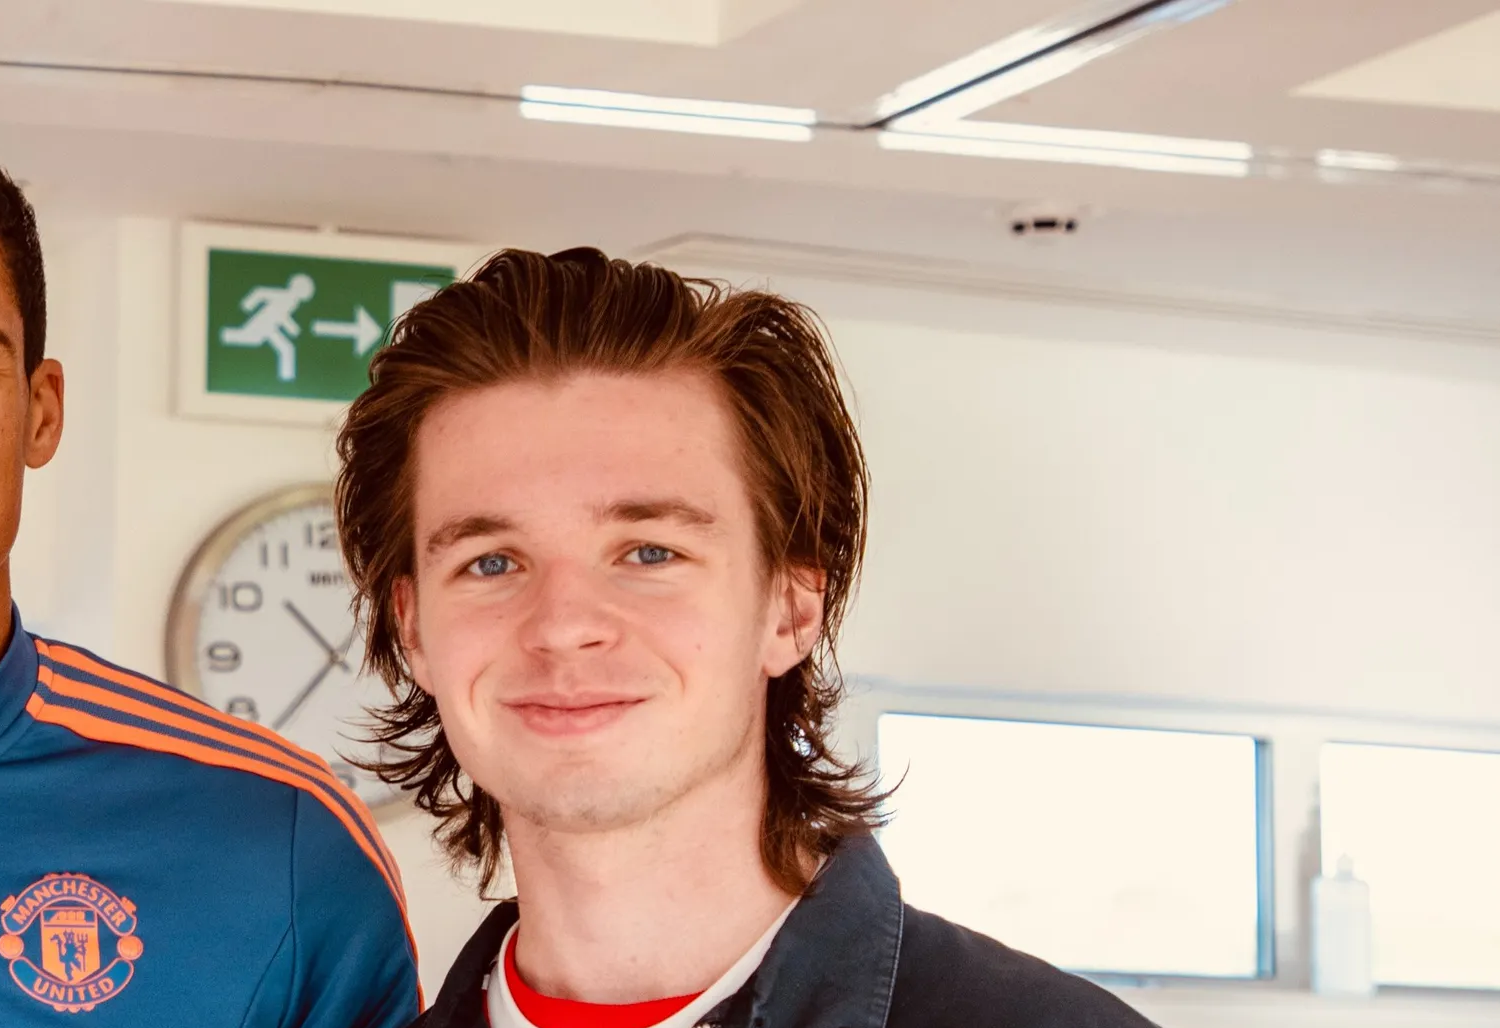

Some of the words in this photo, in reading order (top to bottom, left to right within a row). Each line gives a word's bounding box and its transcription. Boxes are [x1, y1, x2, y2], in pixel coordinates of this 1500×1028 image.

[259, 541, 288, 568] 11
[219, 581, 263, 612] 10
[207, 642, 241, 673] 9
[11, 880, 127, 928] MANCHESTER
[33, 977, 114, 1002] UNITED
